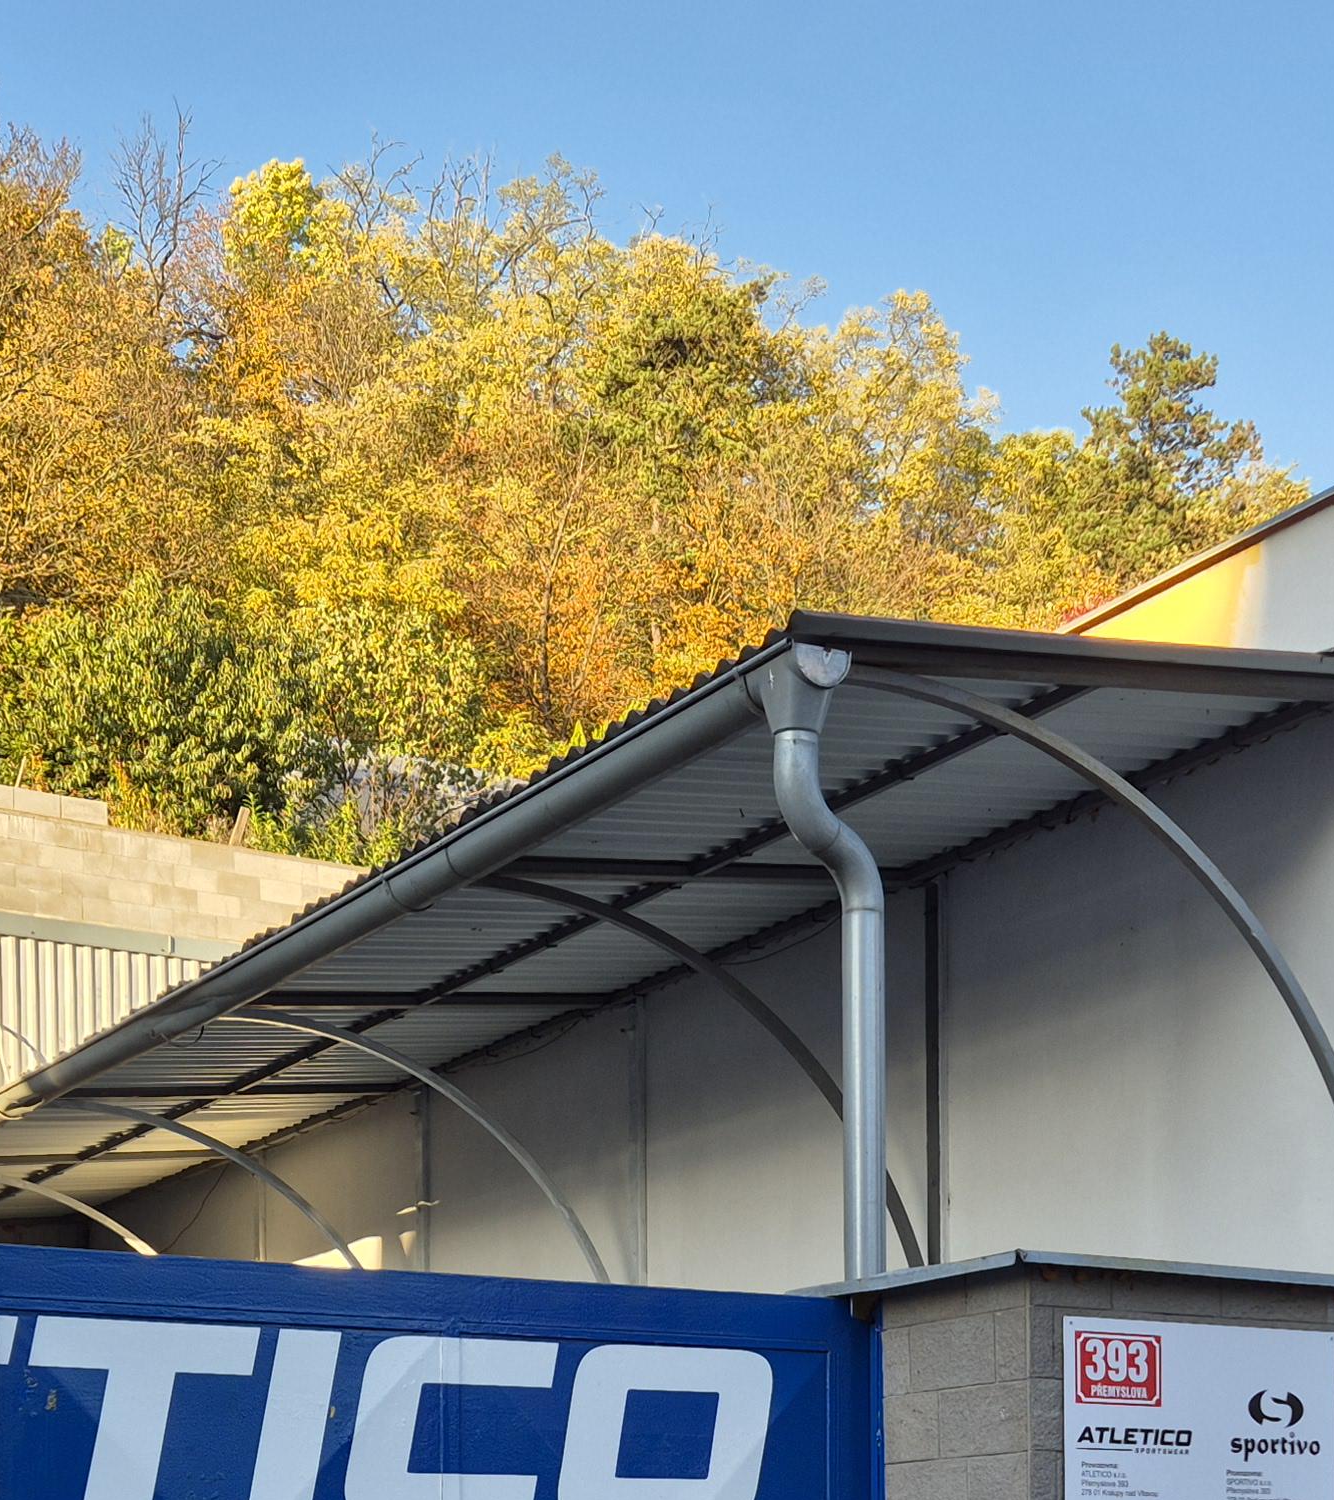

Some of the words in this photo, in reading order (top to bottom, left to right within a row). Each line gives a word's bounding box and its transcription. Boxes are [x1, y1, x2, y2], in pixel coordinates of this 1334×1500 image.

[1085, 1338, 1148, 1383] 393
[1091, 1382, 1147, 1398] PŘEMYSLOVA
[1077, 1426, 1192, 1447] ATLETICO
[1230, 1431, 1320, 1462] sportivo
